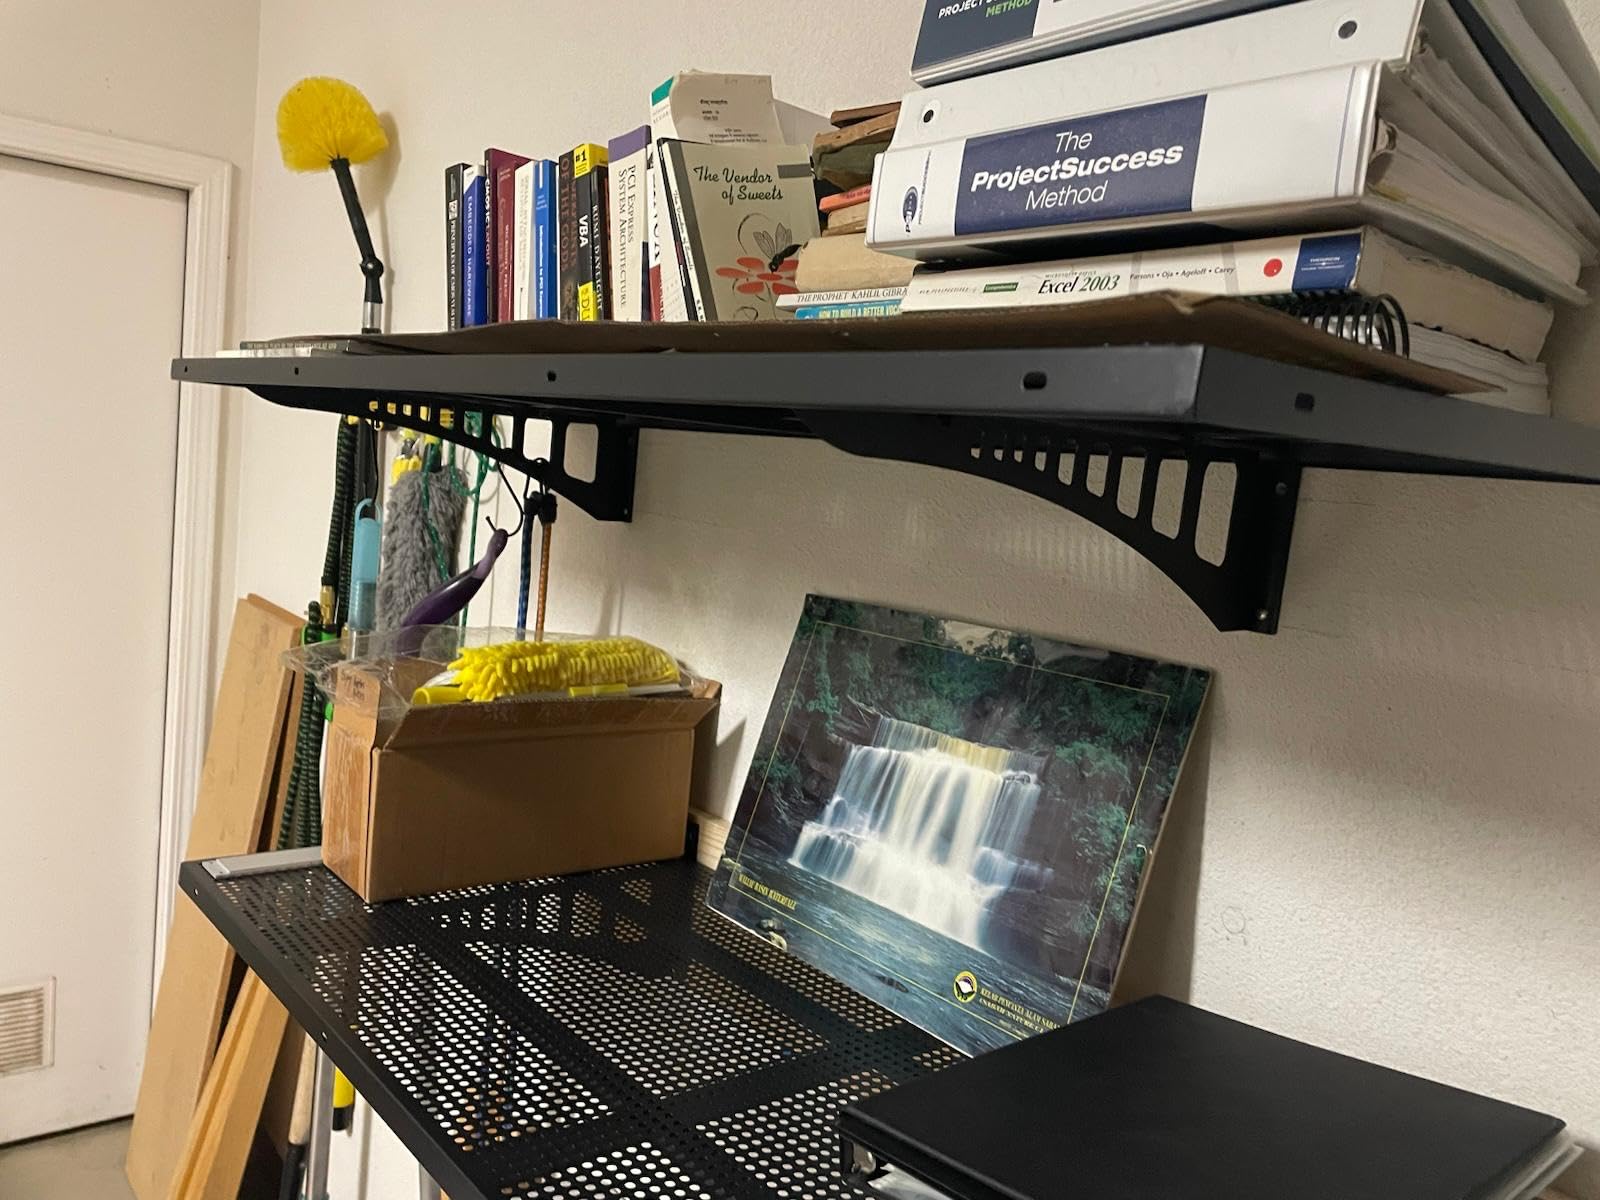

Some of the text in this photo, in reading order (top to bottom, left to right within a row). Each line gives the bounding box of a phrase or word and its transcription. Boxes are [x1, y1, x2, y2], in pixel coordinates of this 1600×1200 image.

[985, 0, 1032, 18] METHOD
[1055, 130, 1093, 153] The
[575, 149, 587, 162] #1
[628, 165, 636, 190] PCI
[693, 165, 772, 183] The Vendor
[970, 145, 1184, 192] ProjectSuccess
[561, 188, 569, 217] THE
[721, 184, 783, 206] of Sweets
[1025, 179, 1109, 211] Method
[579, 215, 589, 248] VBA
[619, 169, 627, 307] SYSTEM ARCHITECTURE
[561, 223, 569, 272] GODS
[594, 245, 602, 310] DAYLIGHT
[1038, 274, 1121, 294] Excel 2003
[1129, 266, 1235, 280] Parsons Oja Ageloff Carey
[797, 287, 908, 303] THE PROPHET KAHLIL GIBRA
[863, 306, 884, 317] BETTER
